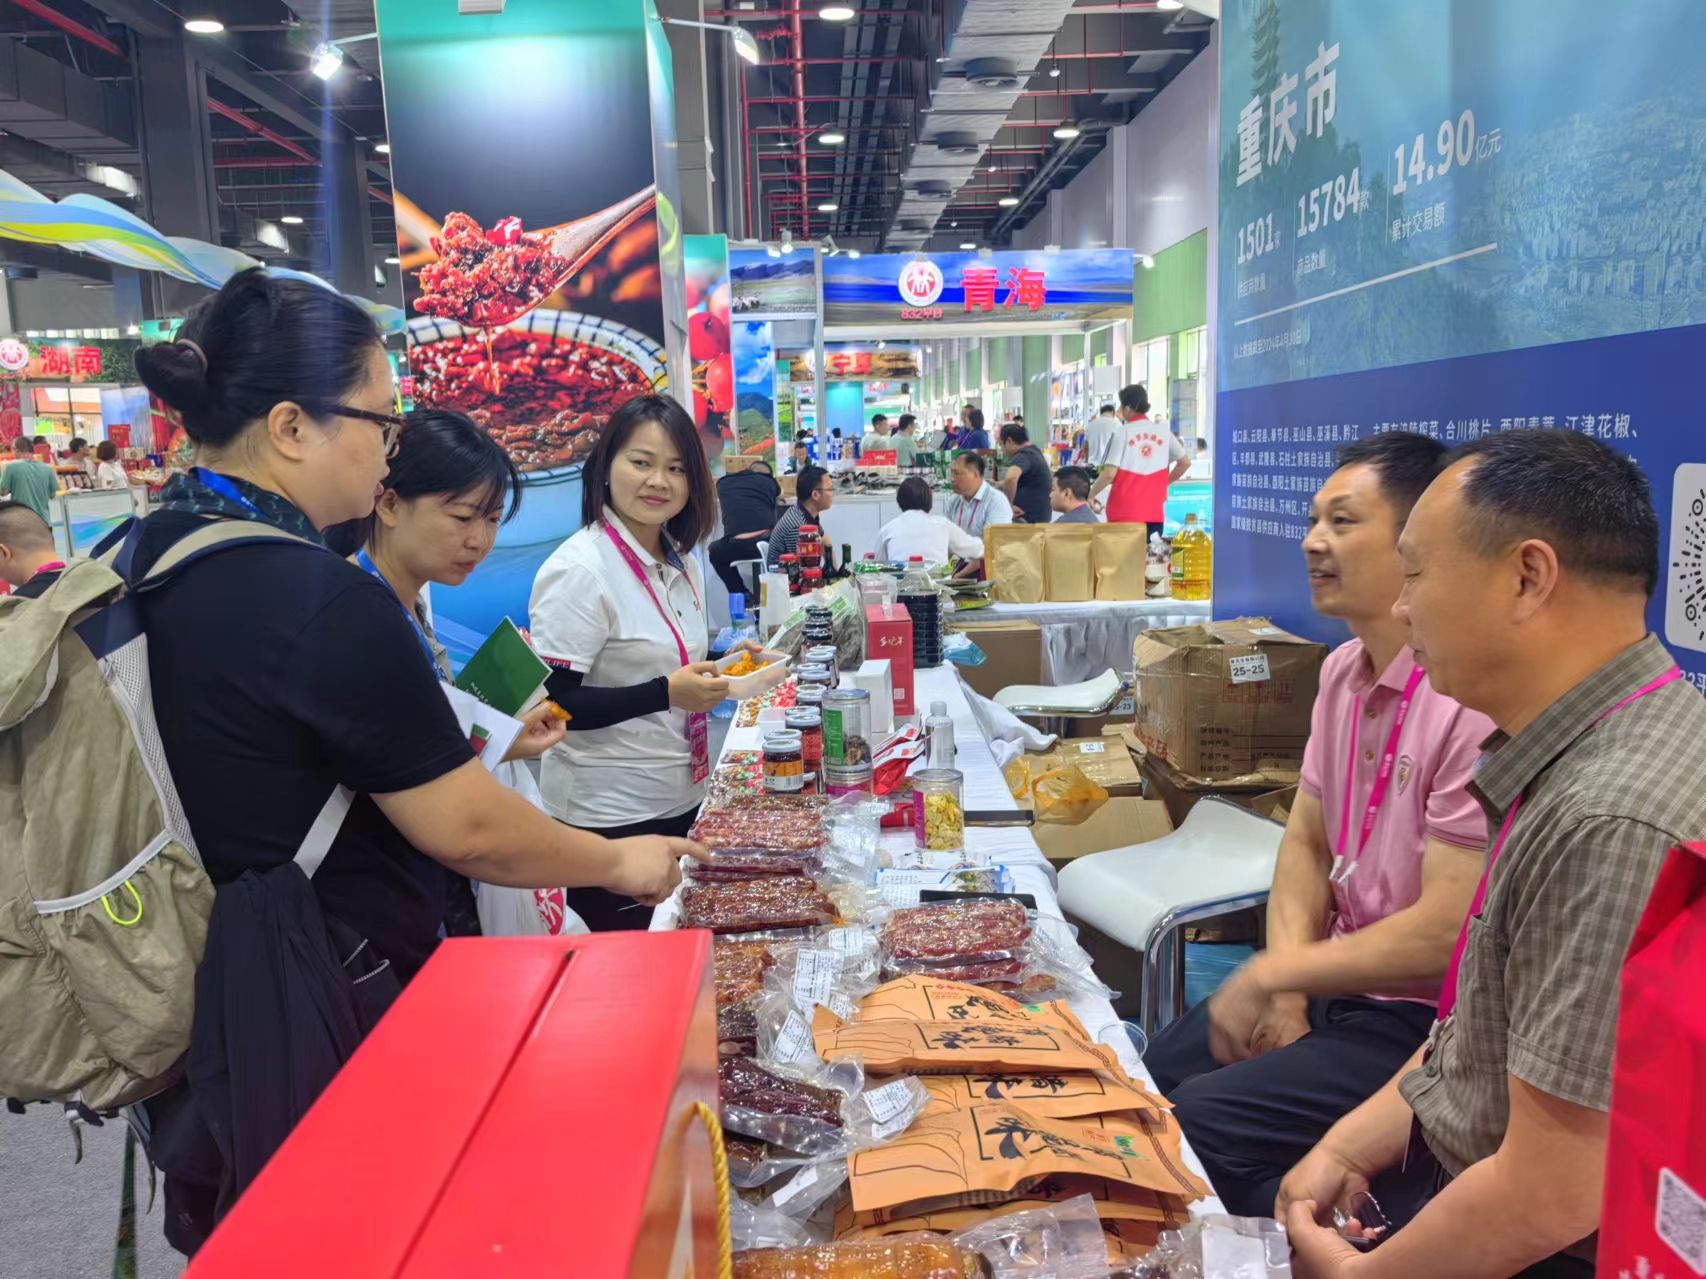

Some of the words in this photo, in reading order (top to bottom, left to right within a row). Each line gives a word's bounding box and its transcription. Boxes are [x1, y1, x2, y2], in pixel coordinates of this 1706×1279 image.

[1236, 41, 1340, 187] 重庆市
[1392, 109, 1502, 196] 14.90亿元
[1391, 201, 1447, 242] 累计交易额
[960, 267, 1047, 312] 青海
[39, 345, 103, 376] 湖南
[1233, 664, 1265, 677] 25-25
